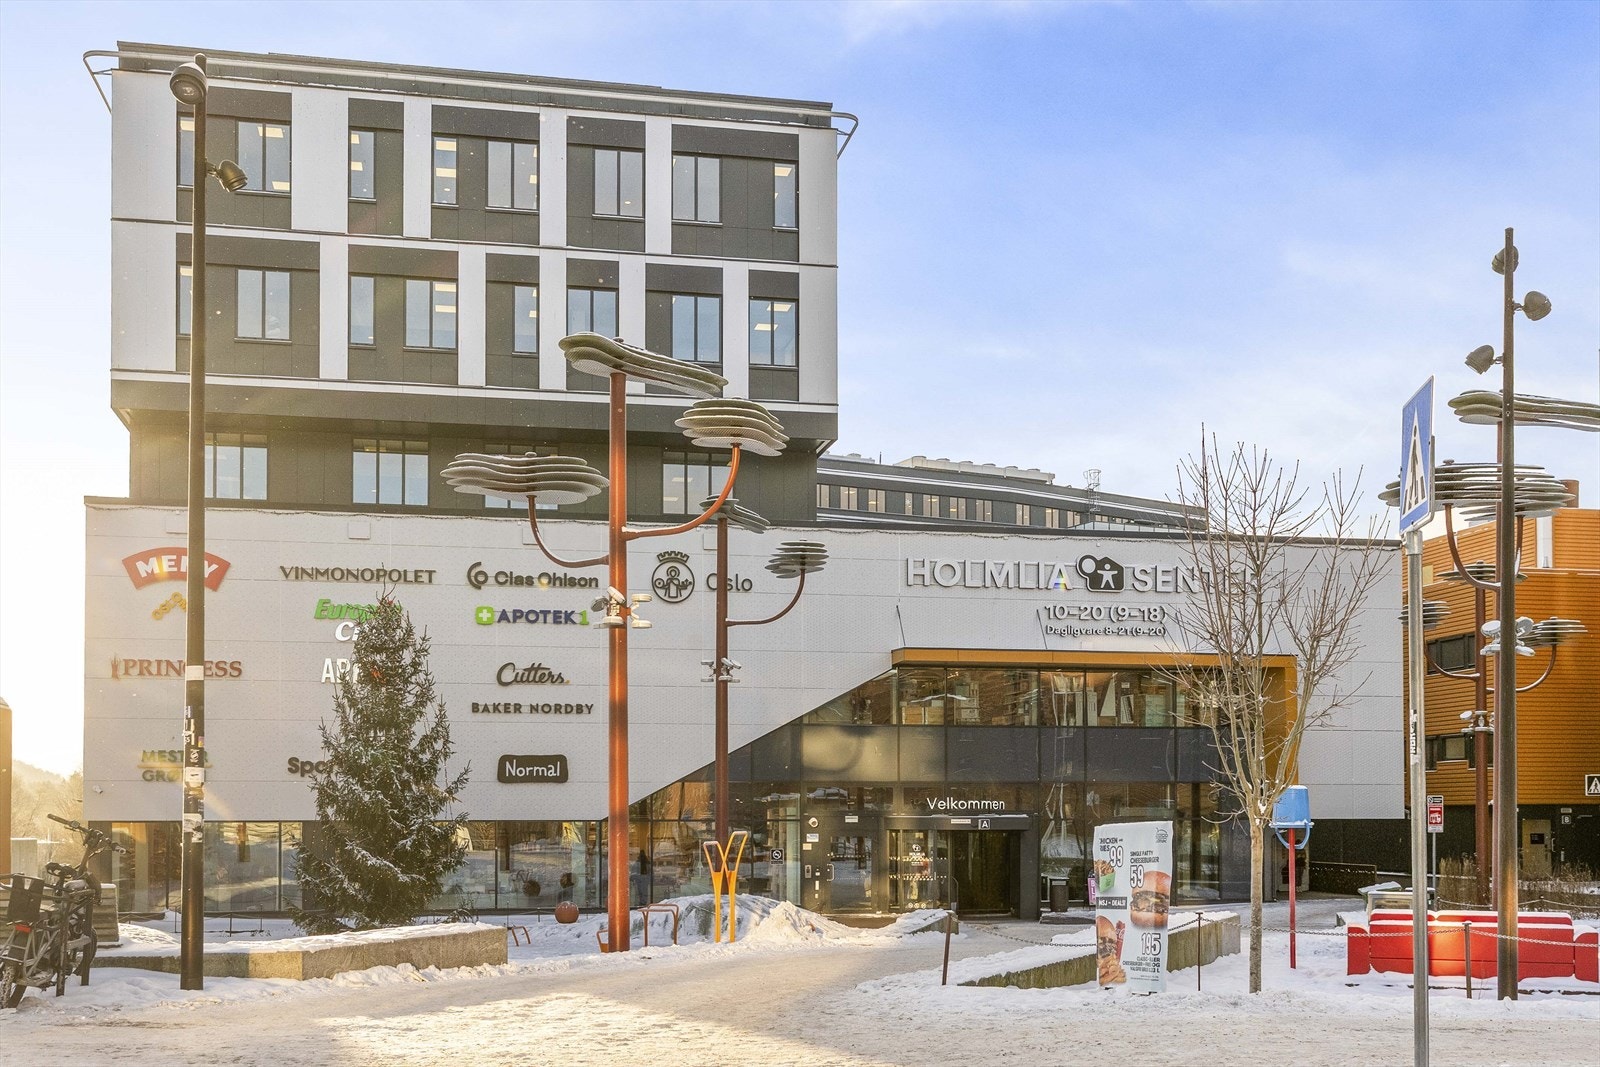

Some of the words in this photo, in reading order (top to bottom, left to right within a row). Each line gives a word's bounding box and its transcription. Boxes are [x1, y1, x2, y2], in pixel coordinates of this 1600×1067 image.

[280, 564, 436, 585] VINMONOPOLET
[495, 570, 534, 586] Clas
[537, 572, 598, 588] Ohlson
[906, 557, 1073, 590] HOLMLIA
[497, 608, 576, 625] APOTEK
[1045, 605, 1105, 620] 10-20
[1109, 603, 1166, 623] (9-18)
[1046, 625, 1102, 637] Dagligvare
[123, 658, 243, 678] PRINESS
[471, 702, 523, 714] BAKER
[529, 703, 594, 715] NORDBY
[505, 759, 561, 777] Normal
[927, 797, 1005, 810] Velkommen
[981, 820, 989, 829] A
[1110, 846, 1124, 867] 99
[1130, 865, 1144, 888] 59
[1141, 933, 1161, 956] 195
